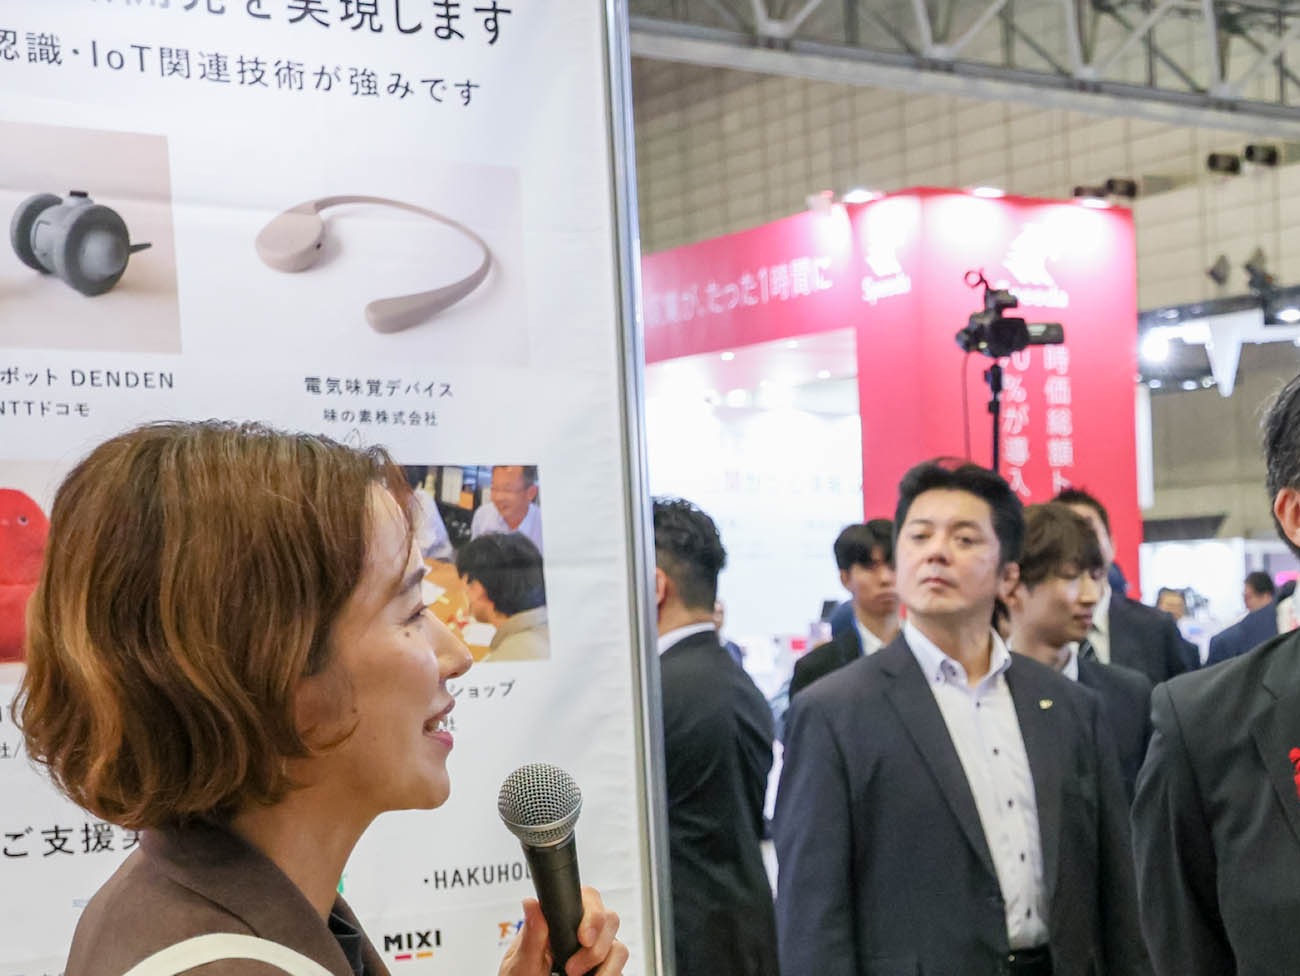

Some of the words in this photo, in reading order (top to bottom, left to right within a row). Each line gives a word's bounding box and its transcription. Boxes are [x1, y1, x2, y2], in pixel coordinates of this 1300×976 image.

[71, 369, 174, 389] DENDEN
[304, 377, 454, 398] 電気味覚デバイス
[322, 408, 439, 427] 味の素株式会社
[384, 930, 441, 952] MIXI
